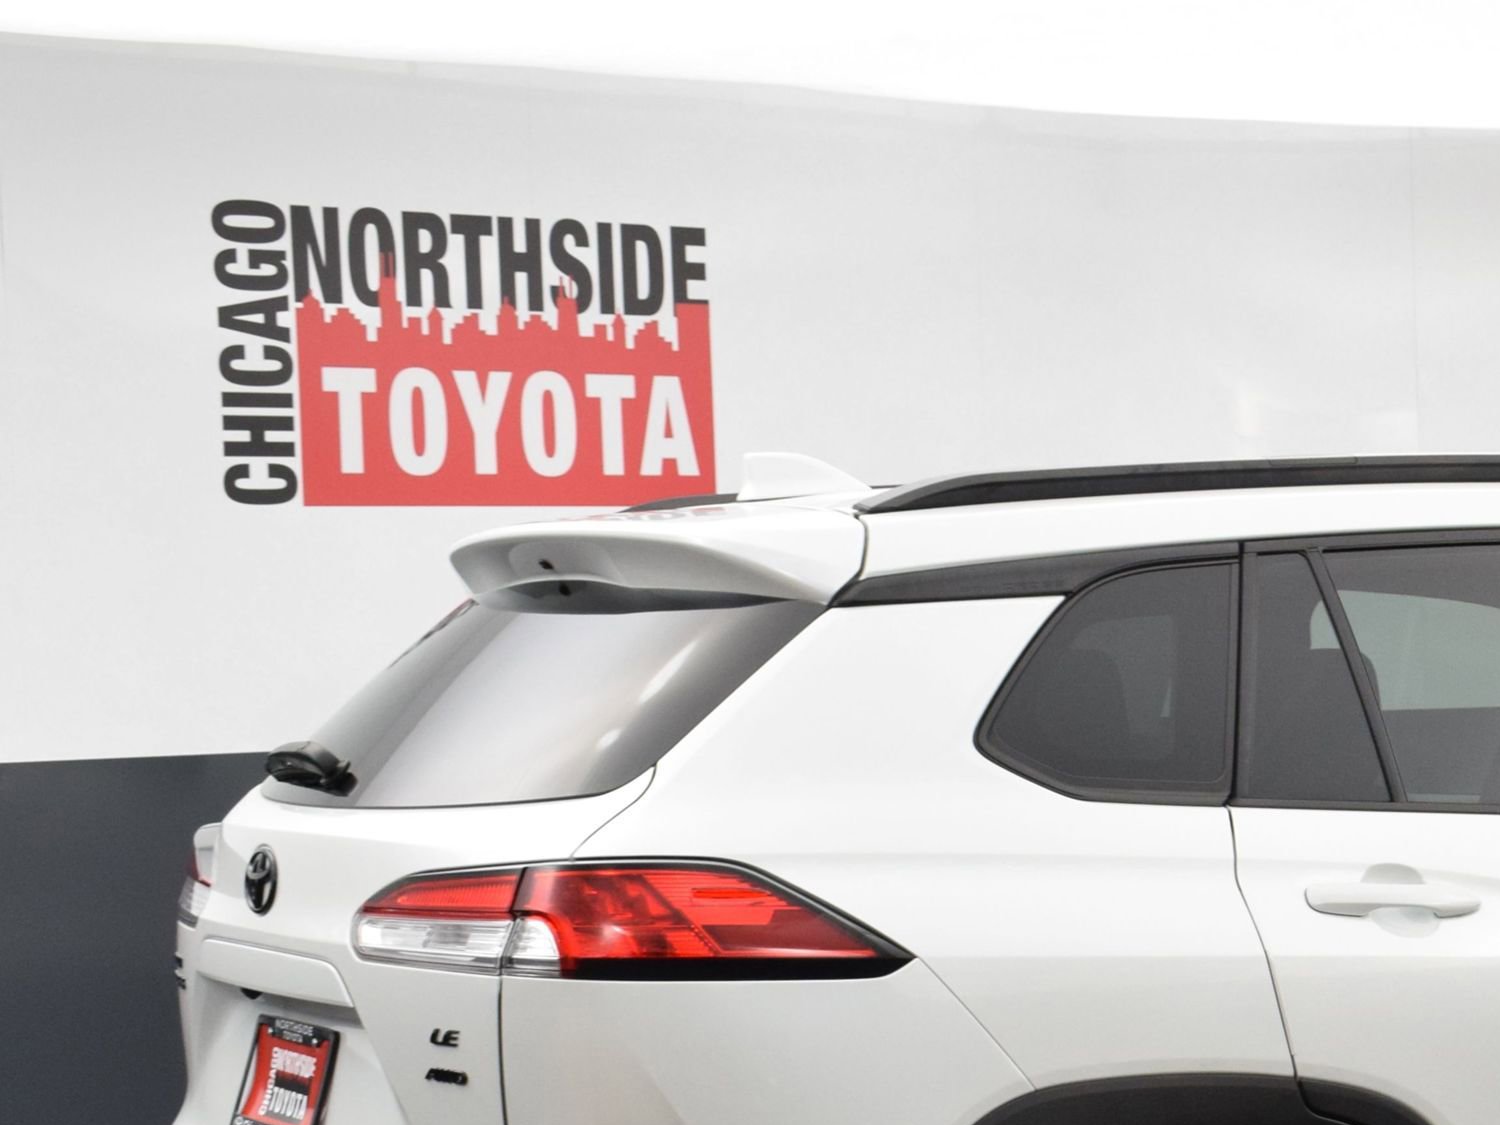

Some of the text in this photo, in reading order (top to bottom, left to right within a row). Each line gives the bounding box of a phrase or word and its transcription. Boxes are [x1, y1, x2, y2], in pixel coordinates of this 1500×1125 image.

[289, 204, 710, 317] NORTHSIDE
[210, 198, 298, 505] CHICAGO
[320, 366, 701, 478] TOYOTA
[430, 1028, 461, 1048] LE
[268, 1086, 308, 1120] TOYOTA
